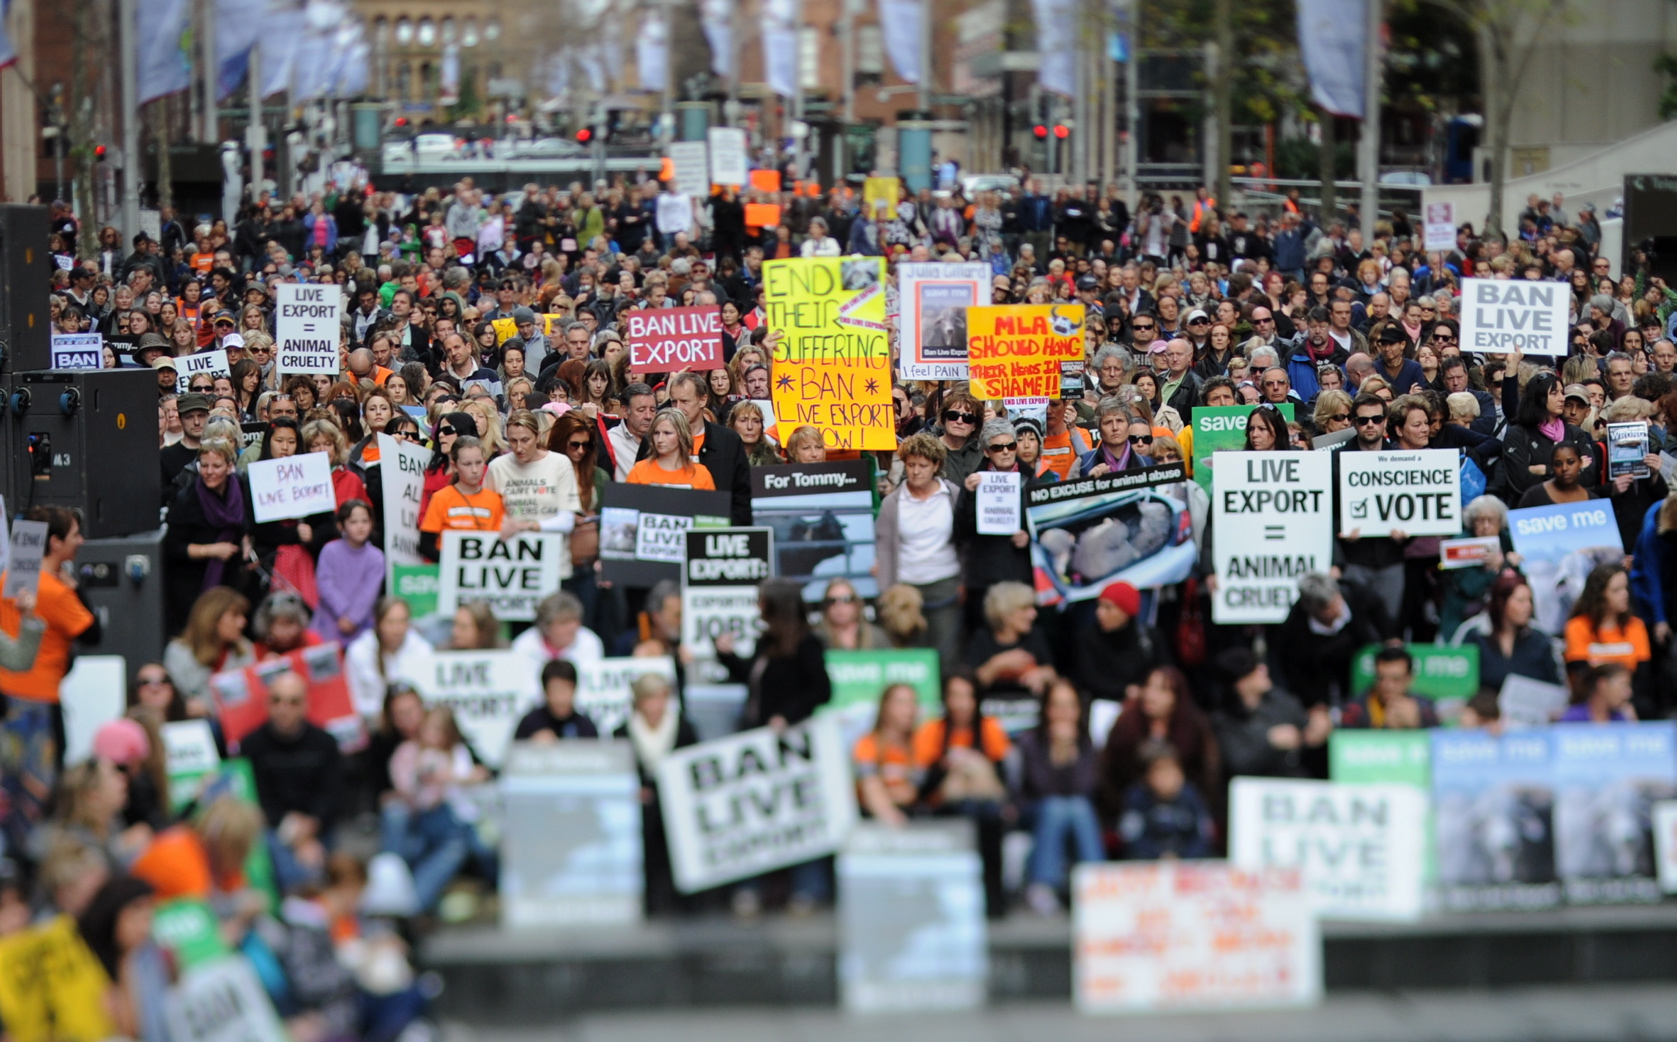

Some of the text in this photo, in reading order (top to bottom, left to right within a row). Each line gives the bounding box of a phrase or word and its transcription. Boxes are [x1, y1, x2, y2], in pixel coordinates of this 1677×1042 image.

[769, 265, 834, 297] END
[924, 288, 969, 297] save me
[295, 288, 324, 301] LIVE
[1476, 283, 1554, 307] BAN
[282, 304, 336, 318] EXPORT
[767, 299, 844, 330] THEIR
[1475, 307, 1553, 331] LIVE
[630, 312, 722, 338] BAN LIVE
[994, 316, 1048, 336] MLA
[283, 339, 335, 352] ANIMAL
[630, 338, 720, 365] EXPORT
[774, 329, 889, 370] SUFFERING
[969, 335, 1040, 359] SHOULD
[1474, 331, 1552, 349] EXPORT
[57, 353, 97, 366] BAN
[186, 356, 214, 372] LIVE
[282, 355, 336, 368] CRUELTY
[923, 348, 937, 356] Ban
[937, 348, 950, 357] Live
[911, 365, 931, 377] feel
[934, 365, 960, 377] PAIN
[969, 363, 1007, 380] THEIR
[1043, 359, 1060, 375] IN
[801, 367, 854, 401] BAN
[1028, 397, 1049, 405] EXPORT
[777, 401, 894, 428] LIVE EXPORT
[1199, 415, 1248, 432] save
[276, 463, 304, 482] BAN
[764, 472, 857, 489] For Tommy...
[990, 474, 1009, 484] LIVE
[1246, 459, 1300, 483] LIVE
[1348, 469, 1453, 487] CONSCIENCE
[532, 486, 557, 496] VOTE
[983, 485, 1017, 494] EXPORT
[1030, 467, 1181, 502] NO EXCUSE for animal abuse
[258, 488, 286, 505] LIVE
[1224, 489, 1324, 513] EXPORT
[1374, 492, 1454, 522] VOTE
[643, 516, 688, 531] BAN
[1516, 509, 1608, 536] save me
[459, 536, 544, 561] BAN
[705, 534, 750, 557] LIVE
[458, 566, 541, 590] LIVE
[436, 662, 491, 687] LIVE
[1425, 653, 1470, 677] me
[690, 728, 814, 791] BAN
[696, 774, 818, 833] LIVE
[1262, 793, 1390, 827] BAN
